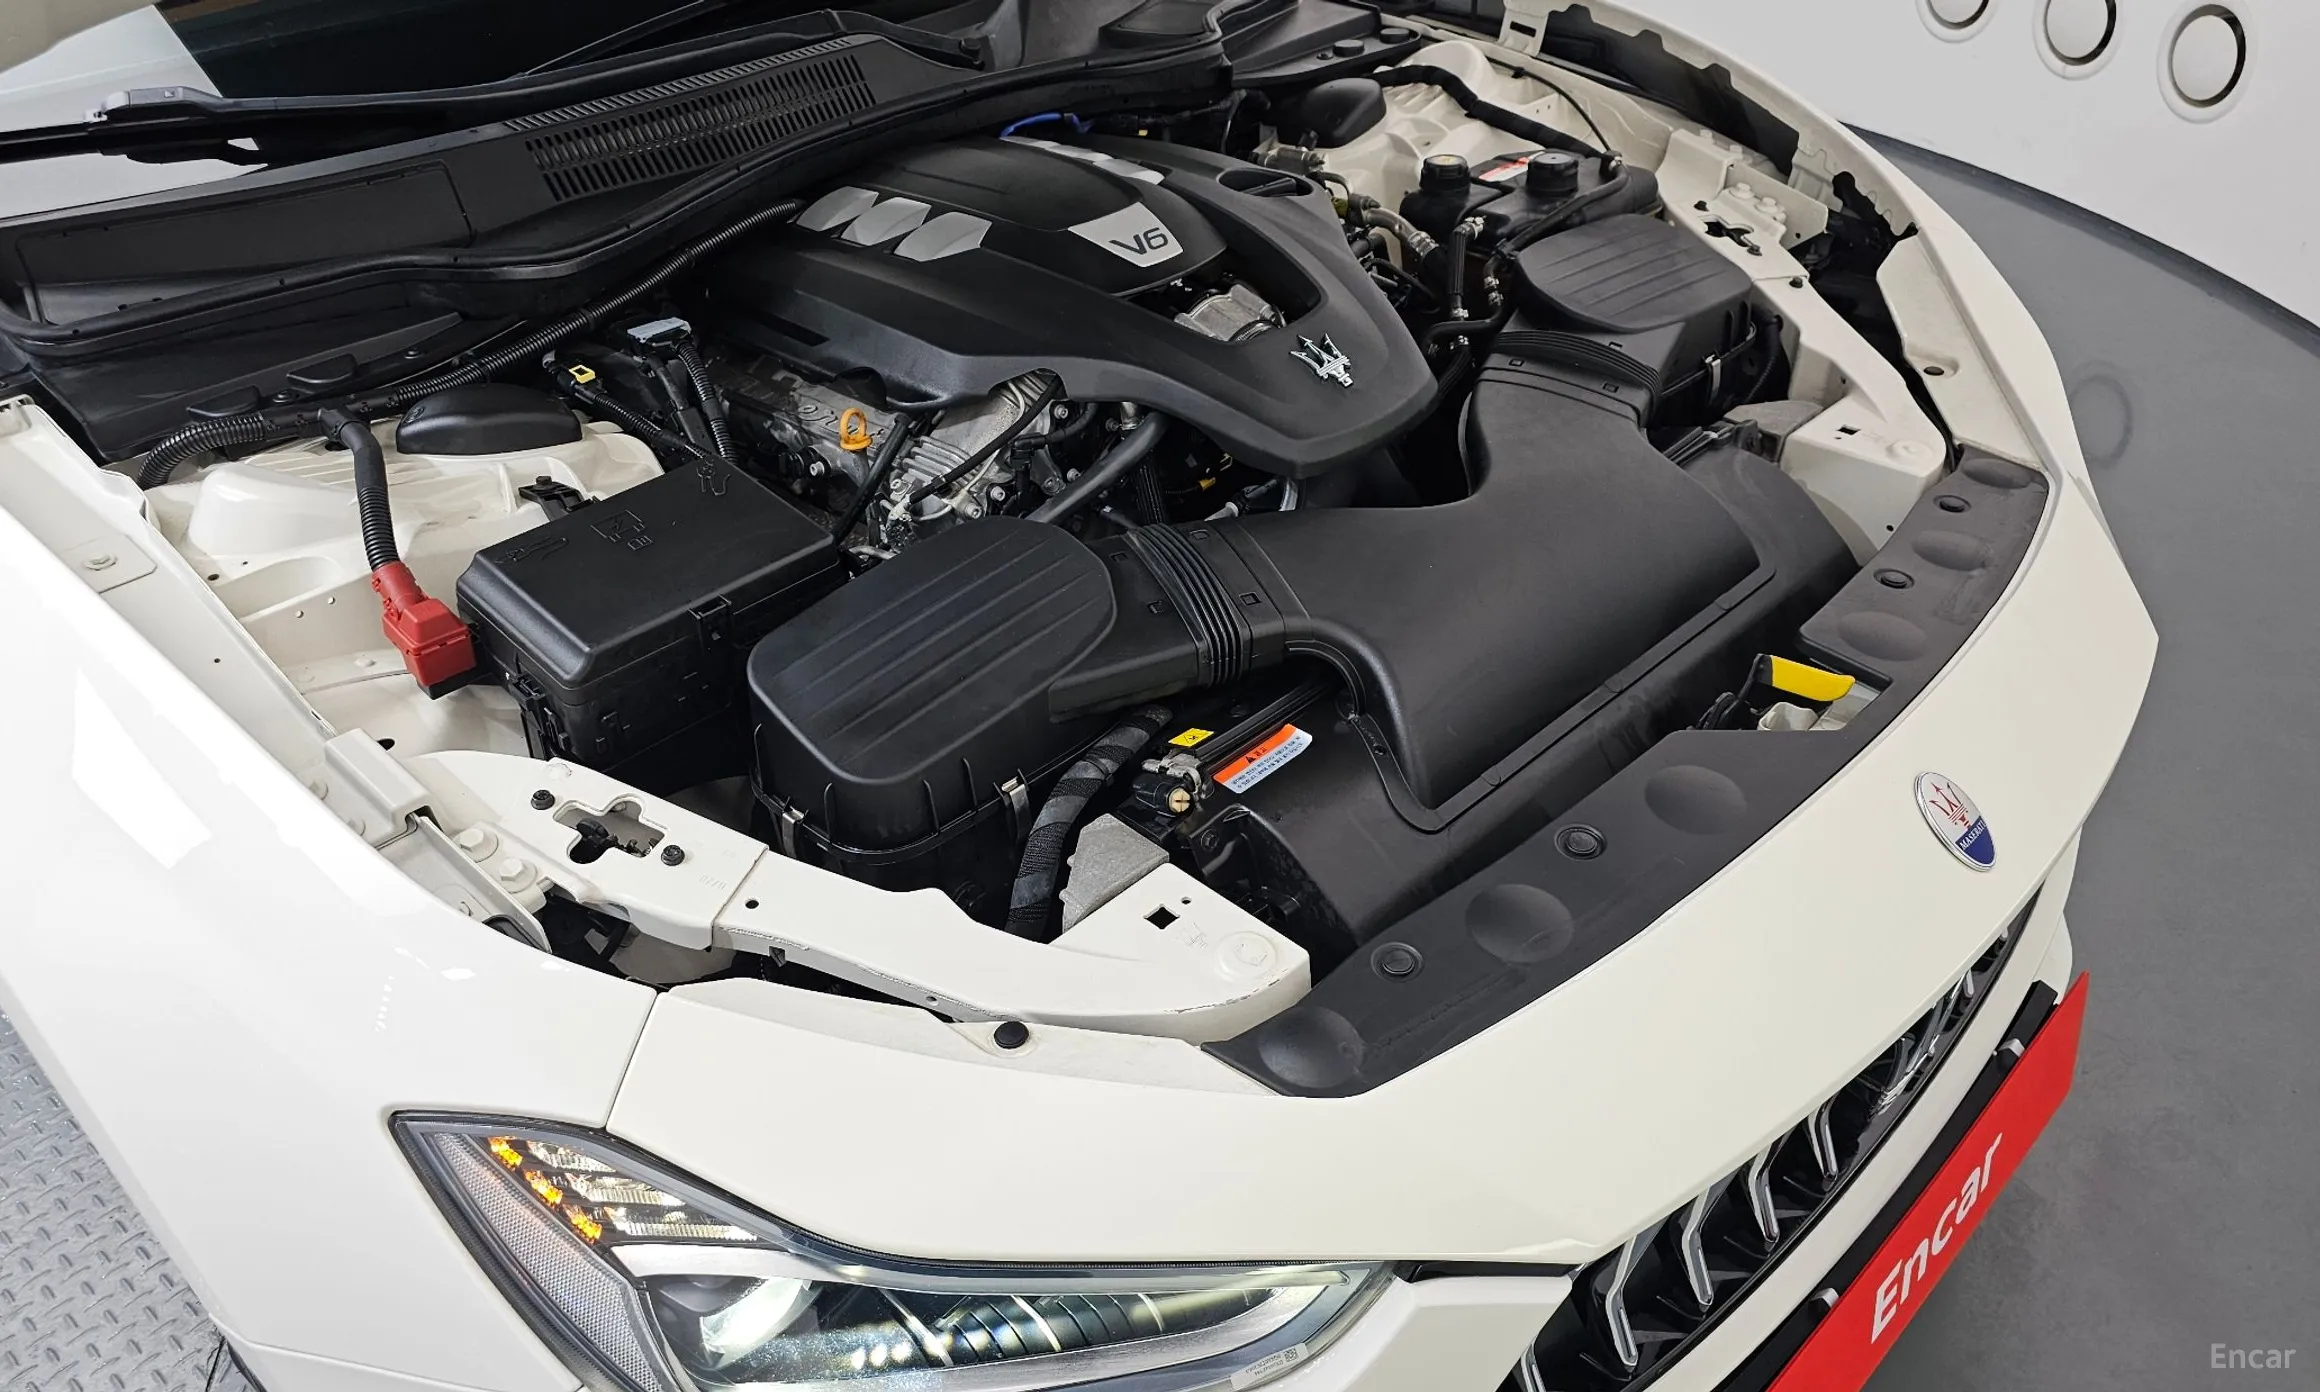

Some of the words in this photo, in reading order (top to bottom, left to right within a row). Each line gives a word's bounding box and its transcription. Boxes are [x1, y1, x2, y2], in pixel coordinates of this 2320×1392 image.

[1108, 227, 1168, 255] V6
[1959, 819, 1987, 851] MASERATI
[1871, 1132, 2003, 1344] Encar
